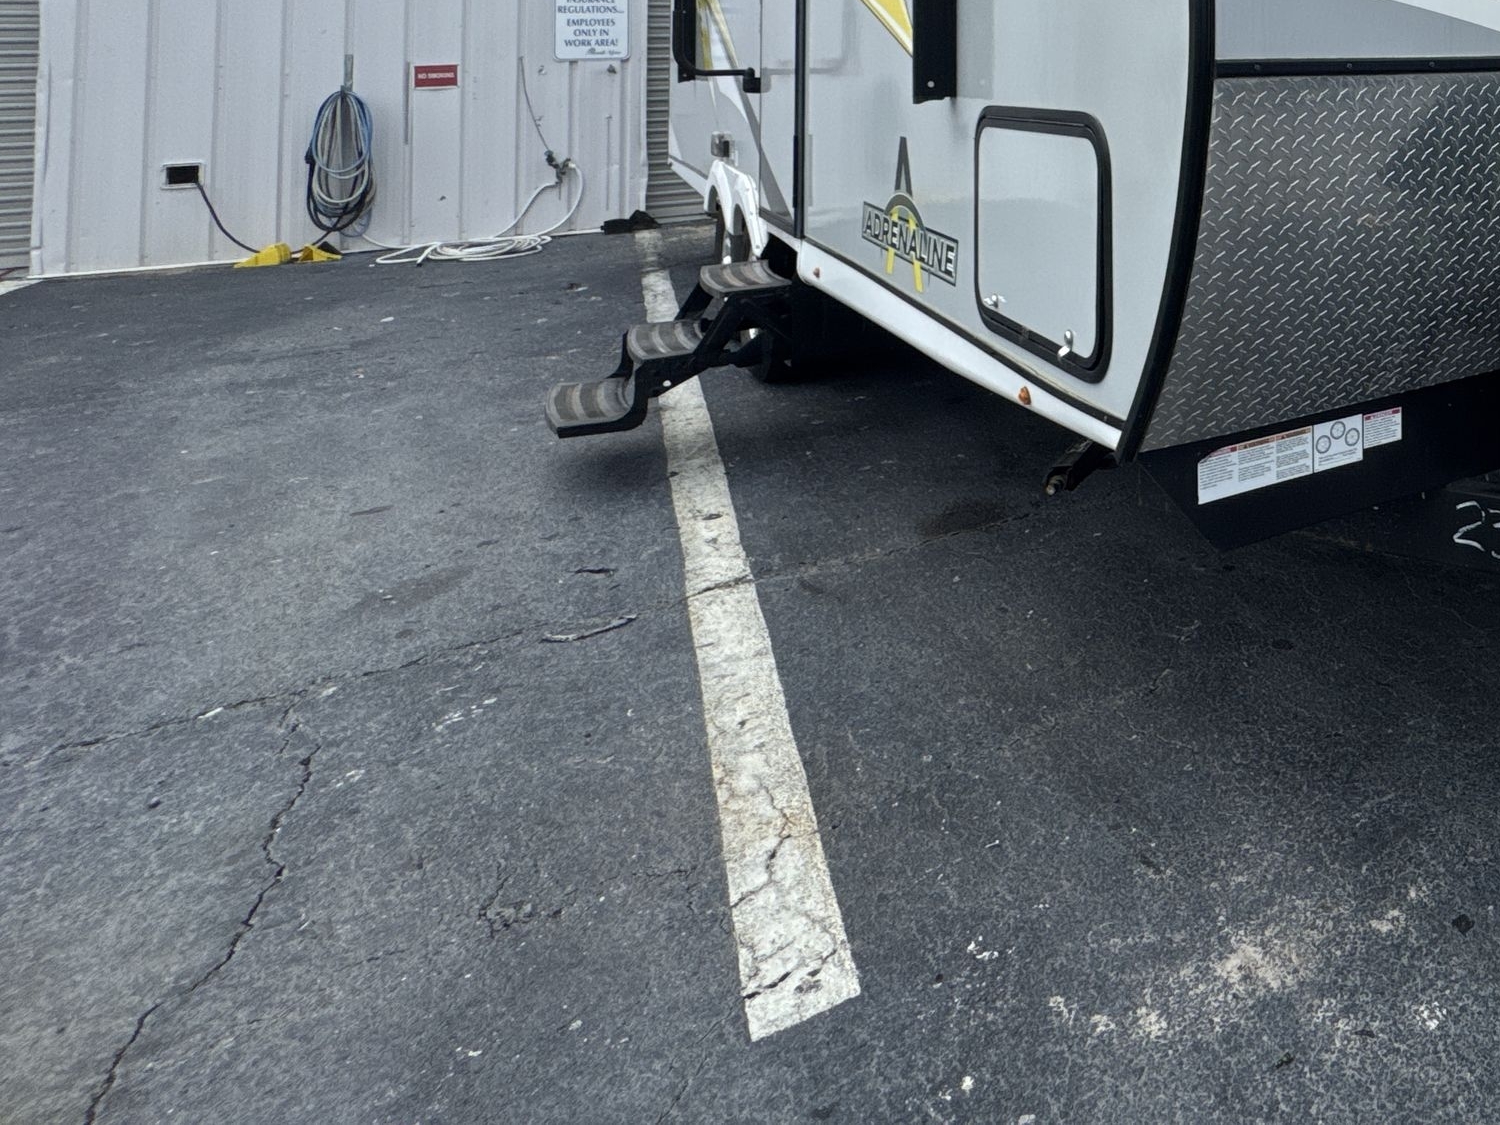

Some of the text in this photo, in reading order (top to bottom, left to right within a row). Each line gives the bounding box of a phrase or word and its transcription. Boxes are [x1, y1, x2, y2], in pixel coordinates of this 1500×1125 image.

[566, 18, 616, 27] EMPLOYEES
[573, 28, 610, 37] ONLY IN
[564, 38, 619, 47] WORK AREA!
[864, 209, 956, 278] ADRENALINE
